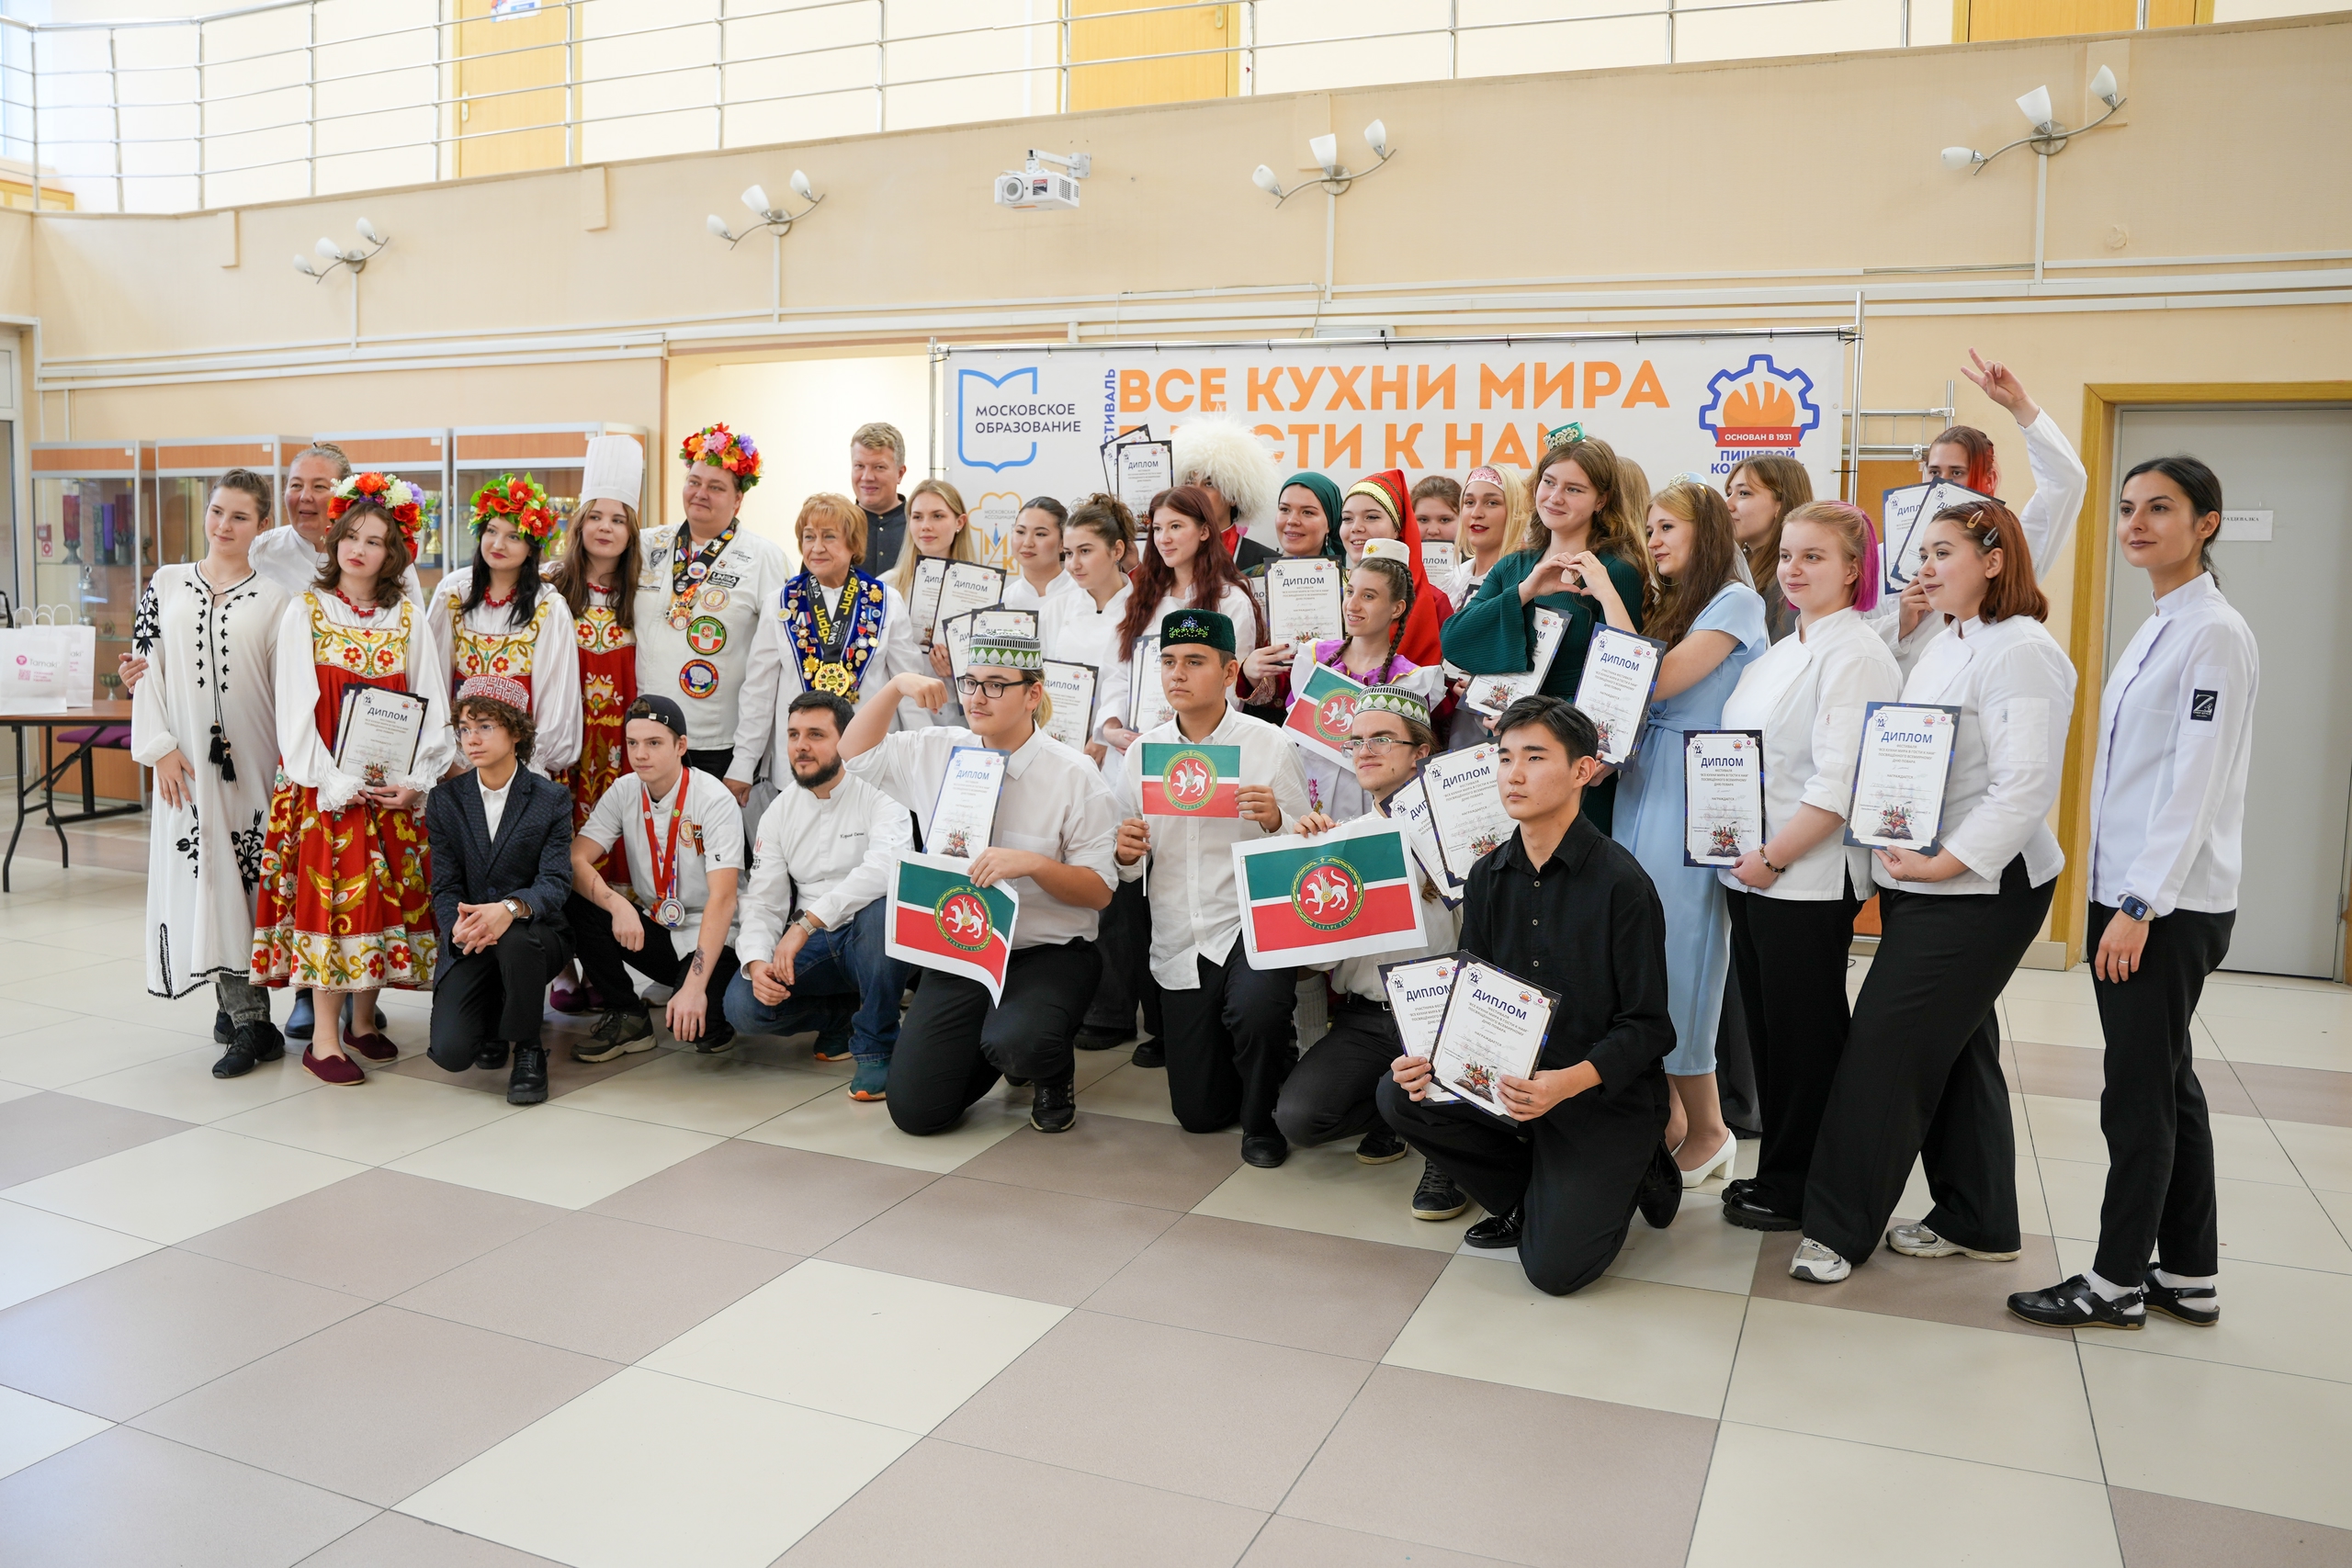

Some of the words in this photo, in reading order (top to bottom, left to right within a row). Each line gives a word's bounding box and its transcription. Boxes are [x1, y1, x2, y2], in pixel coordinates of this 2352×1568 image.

[1119, 368, 1227, 412] ВСЕ
[1247, 364, 1456, 412] КУХНИ
[1479, 360, 1670, 409] МИРА
[976, 403, 1076, 416] МОСКОВСКОЕ
[1104, 368, 1115, 443] СТИВАЛЬ
[976, 421, 1081, 434] ОБРАЗОВАНИЕ
[1385, 423, 1424, 469] К
[1128, 461, 1159, 469] ДИПЛОМ
[1897, 504, 1921, 516] ДИПЛ
[924, 575, 943, 583] ДИПЛ
[1283, 577, 1325, 587] ДИПЛОМ
[954, 581, 988, 592] ДИПЛОМ
[840, 577, 859, 615] Judge
[1600, 652, 1640, 671] ДИПЛОМ
[1044, 680, 1080, 691] ДИПЛОМ
[368, 707, 408, 722] ДИПЛОМ
[1881, 731, 1932, 743] ДИПЛОМ
[1701, 758, 1744, 768] ДИПЛОМ
[956, 770, 989, 780] ДИПЛОМ
[1442, 766, 1490, 789] ДИПЛОМ
[1313, 917, 1351, 931] ТАТАРСТАН
[949, 938, 980, 951] ТАТАРСТАН
[1472, 988, 1527, 1020] ДИПЛОМ
